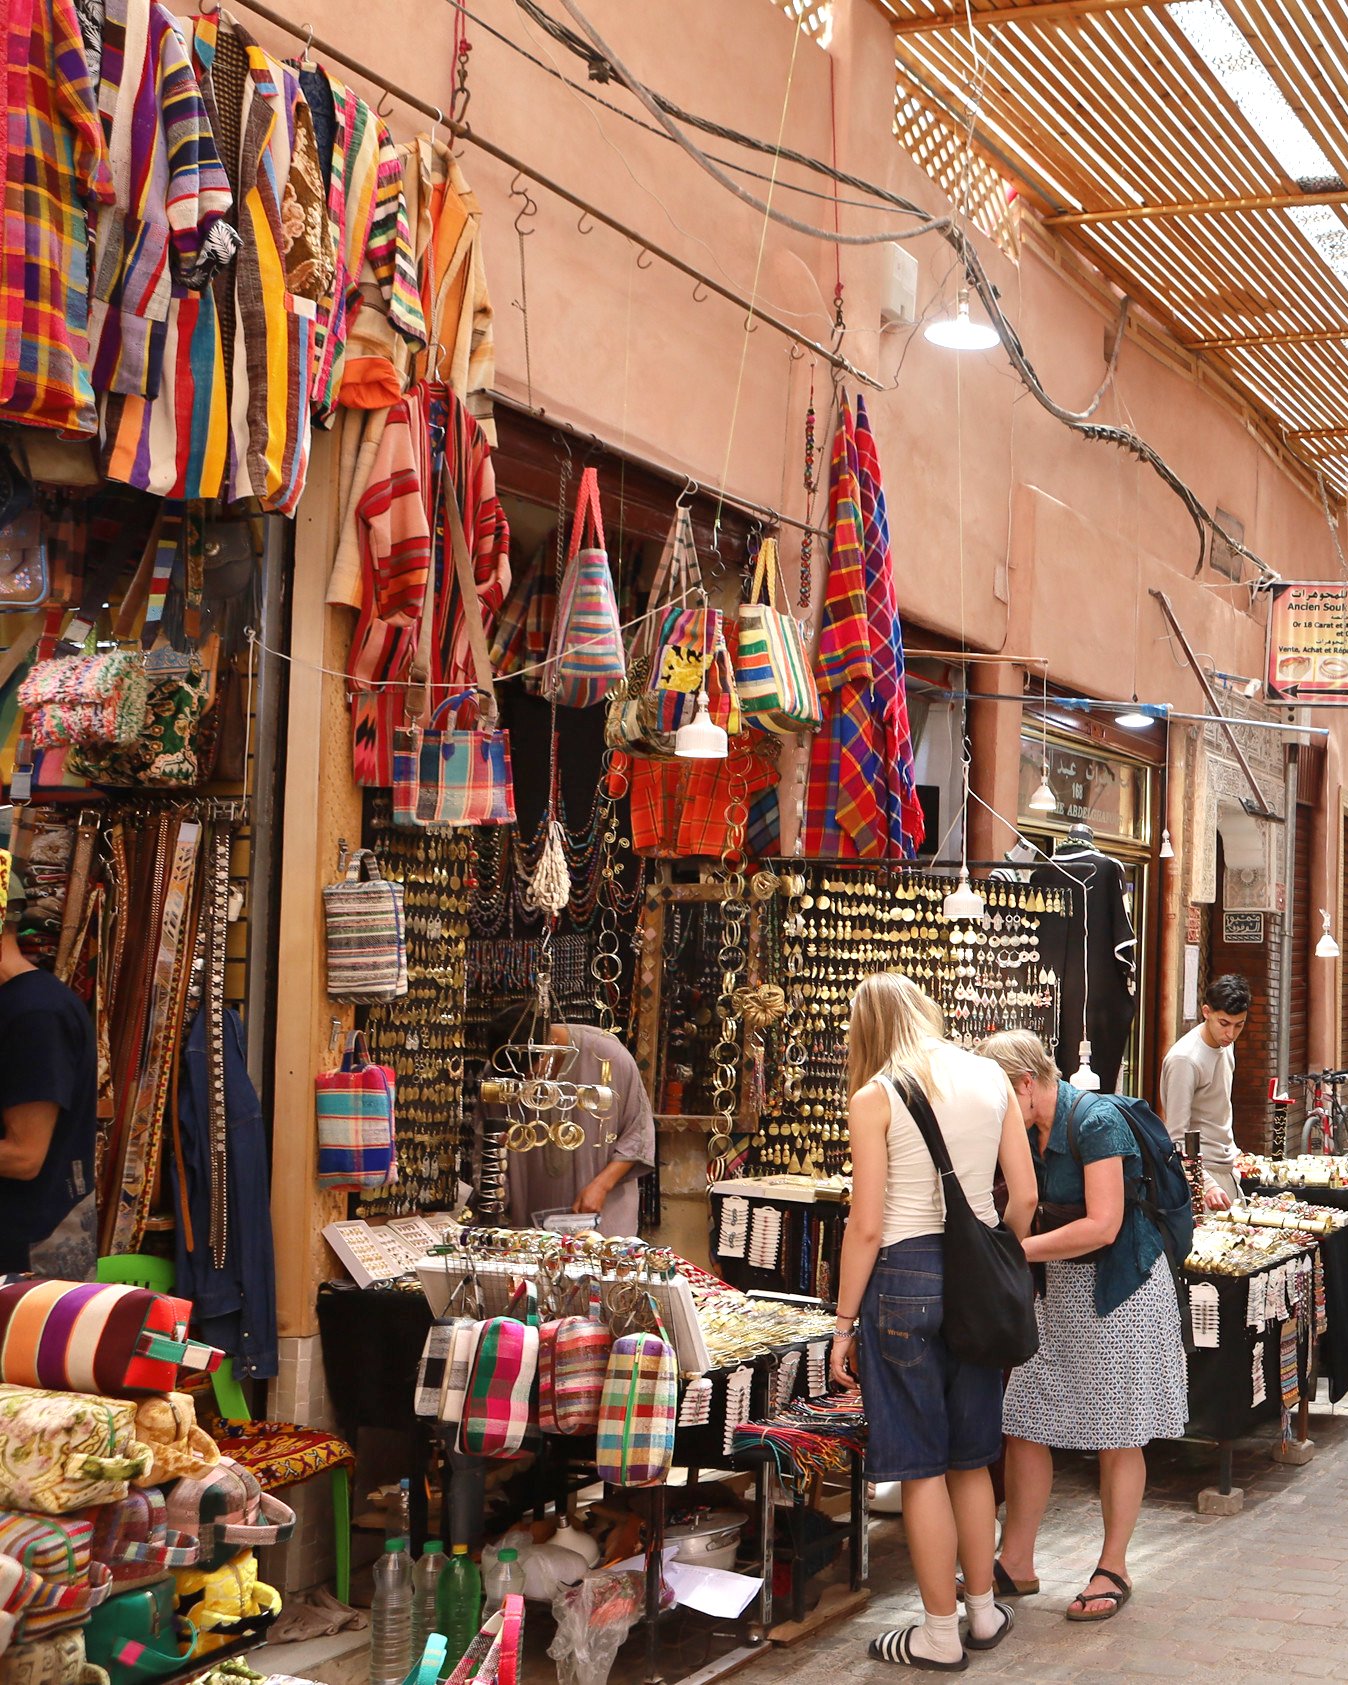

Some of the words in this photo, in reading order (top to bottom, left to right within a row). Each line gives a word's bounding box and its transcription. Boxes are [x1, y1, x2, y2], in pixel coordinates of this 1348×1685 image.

[1291, 589, 1348, 601] للمجوهرات
[1287, 603, 1320, 611] Ancien
[1323, 603, 1347, 611] Souk
